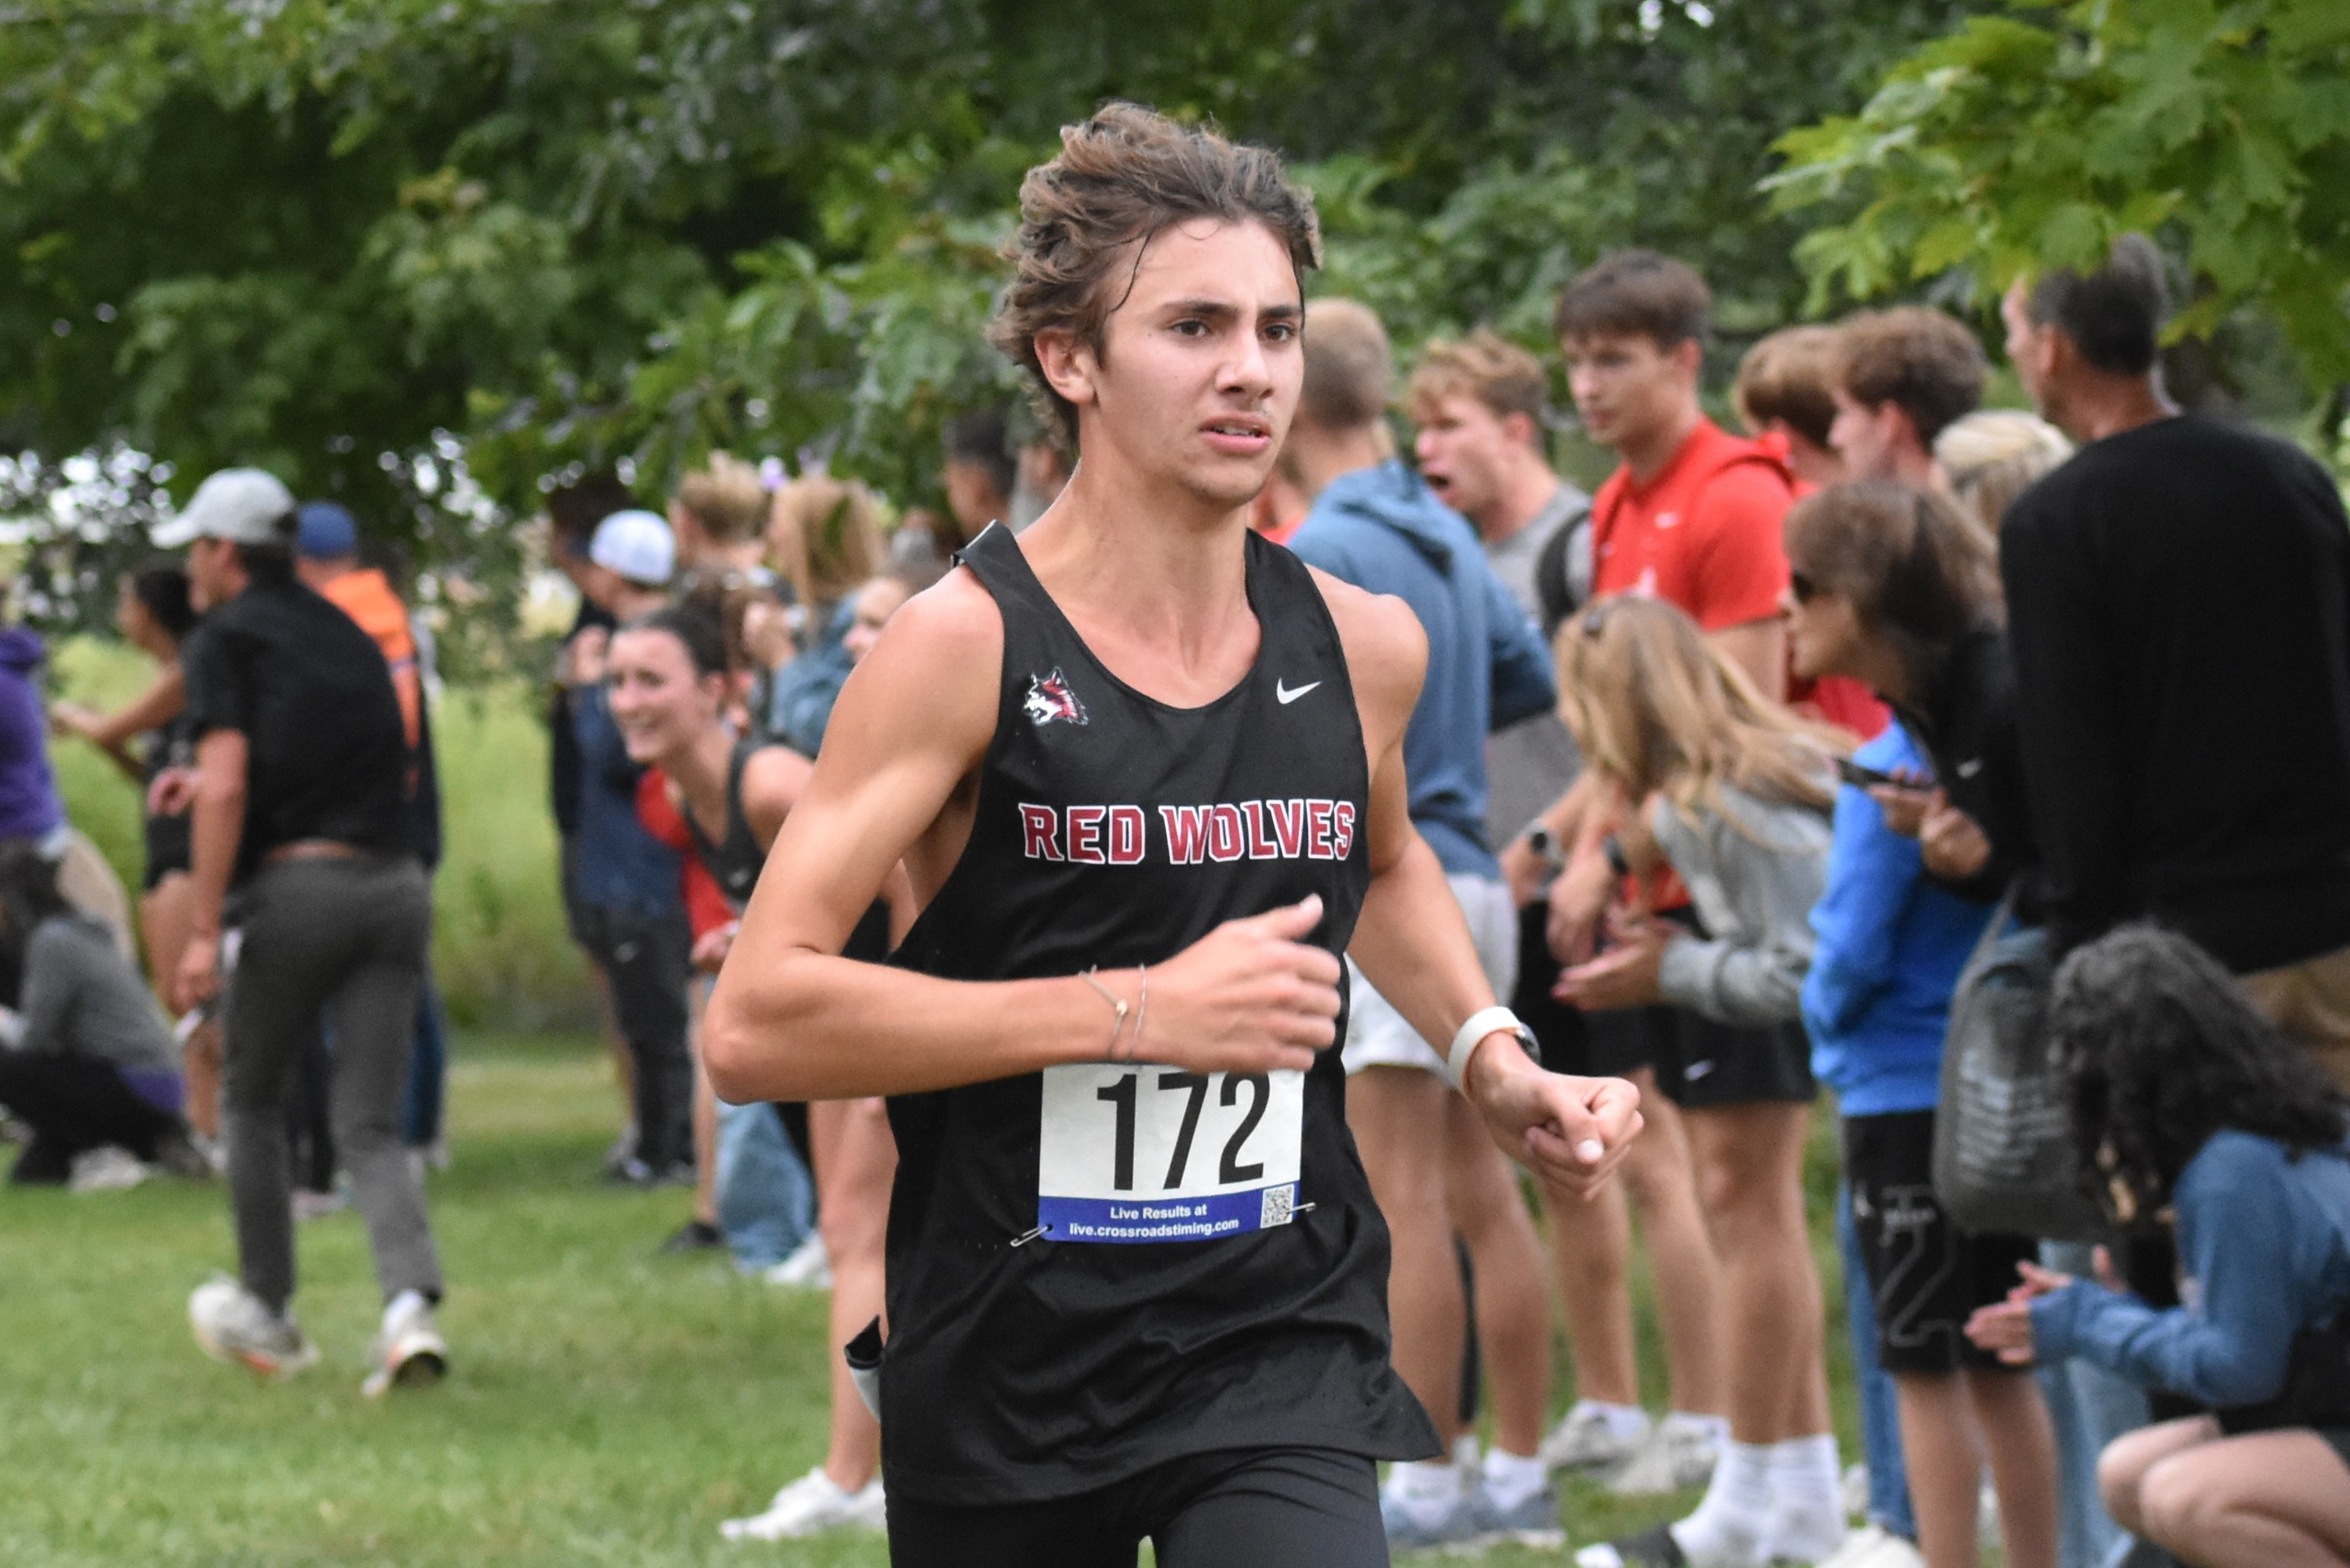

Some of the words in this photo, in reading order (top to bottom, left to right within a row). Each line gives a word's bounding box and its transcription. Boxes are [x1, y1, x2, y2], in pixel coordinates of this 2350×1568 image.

[1018, 802, 1145, 865] RED
[1158, 798, 1356, 865] WOLVES
[1096, 1071, 1271, 1191] 172
[1069, 1219, 1239, 1237] live.crossroadstiming.com
[1110, 1207, 1139, 1219] Live
[1142, 1205, 1191, 1219] Results
[1194, 1204, 1207, 1216] at
